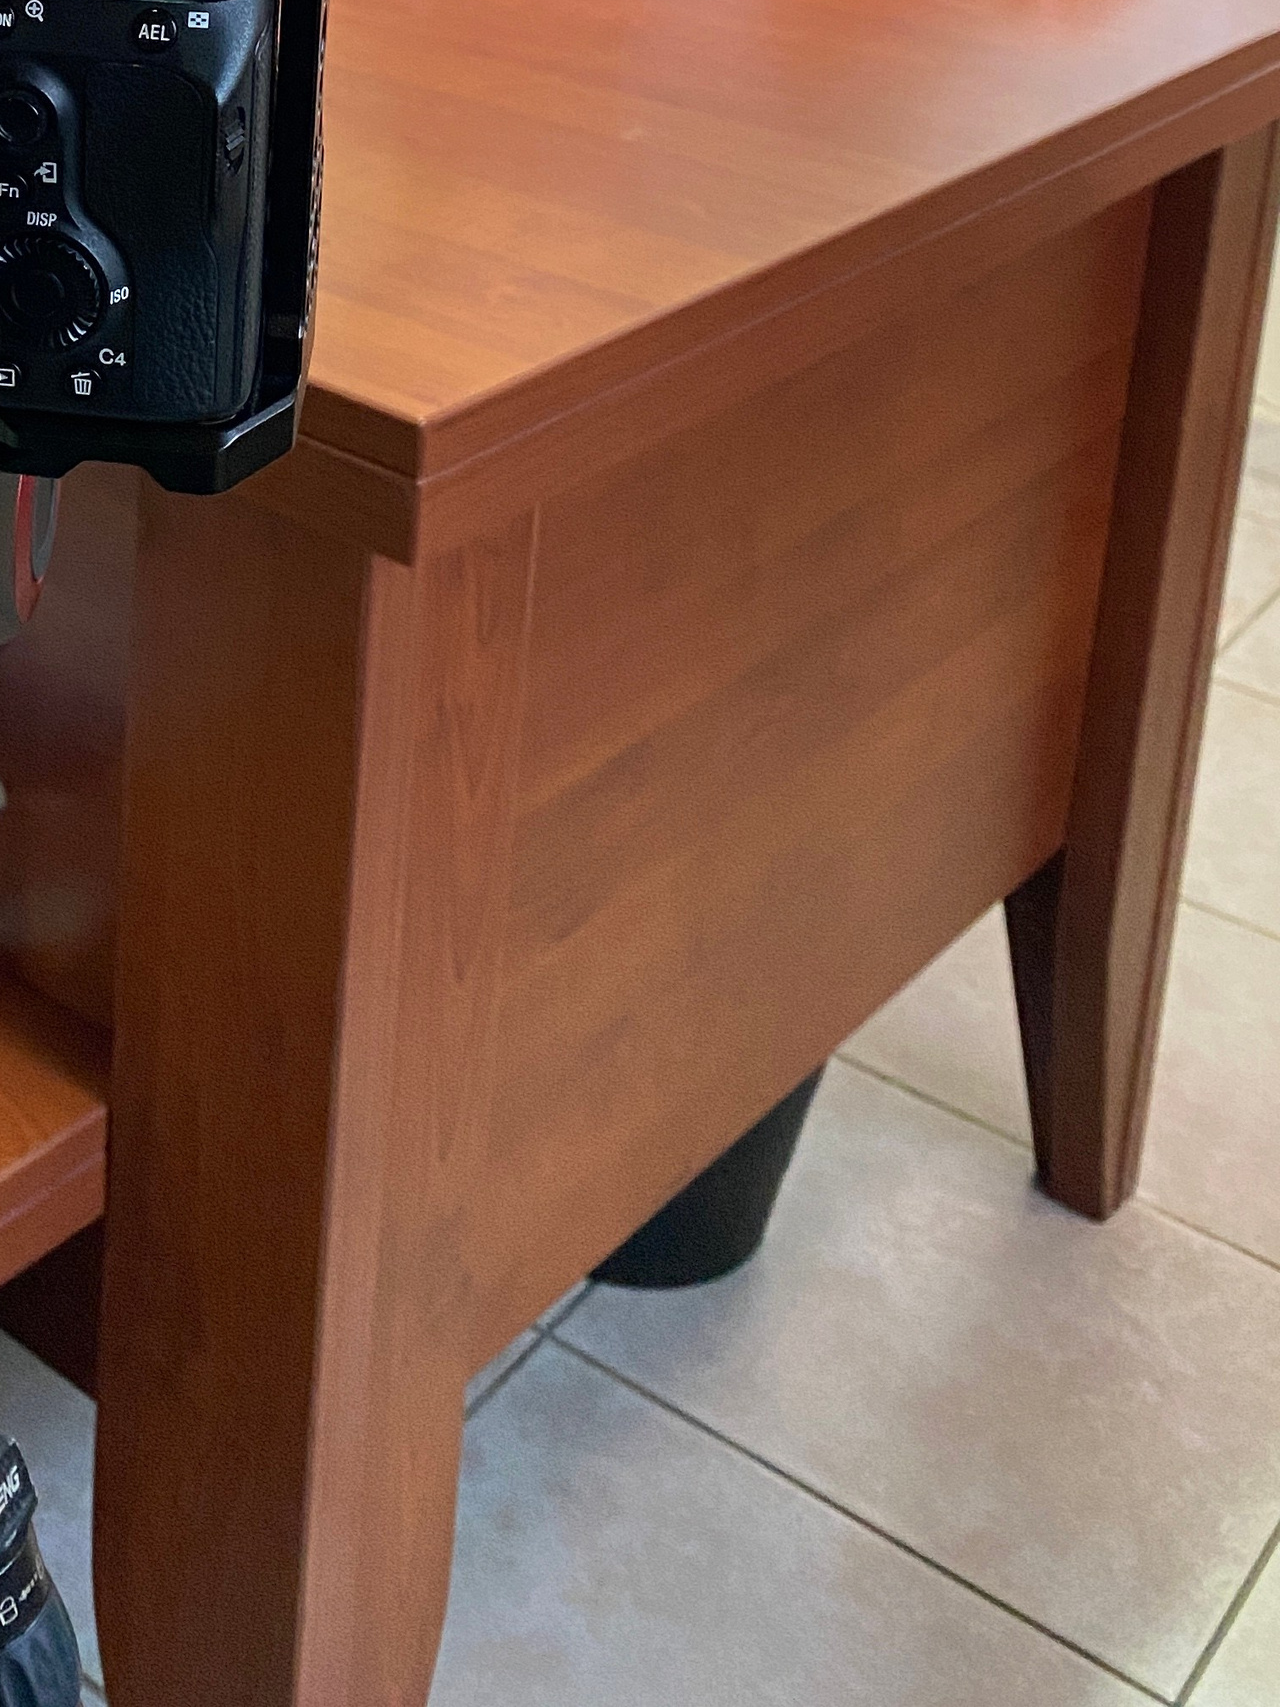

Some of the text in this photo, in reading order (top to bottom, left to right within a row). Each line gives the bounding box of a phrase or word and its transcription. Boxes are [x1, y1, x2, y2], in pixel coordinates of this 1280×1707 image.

[138, 24, 170, 42] AEL
[27, 211, 57, 227] DISP
[109, 286, 130, 305] ISO
[99, 348, 126, 366] C4
